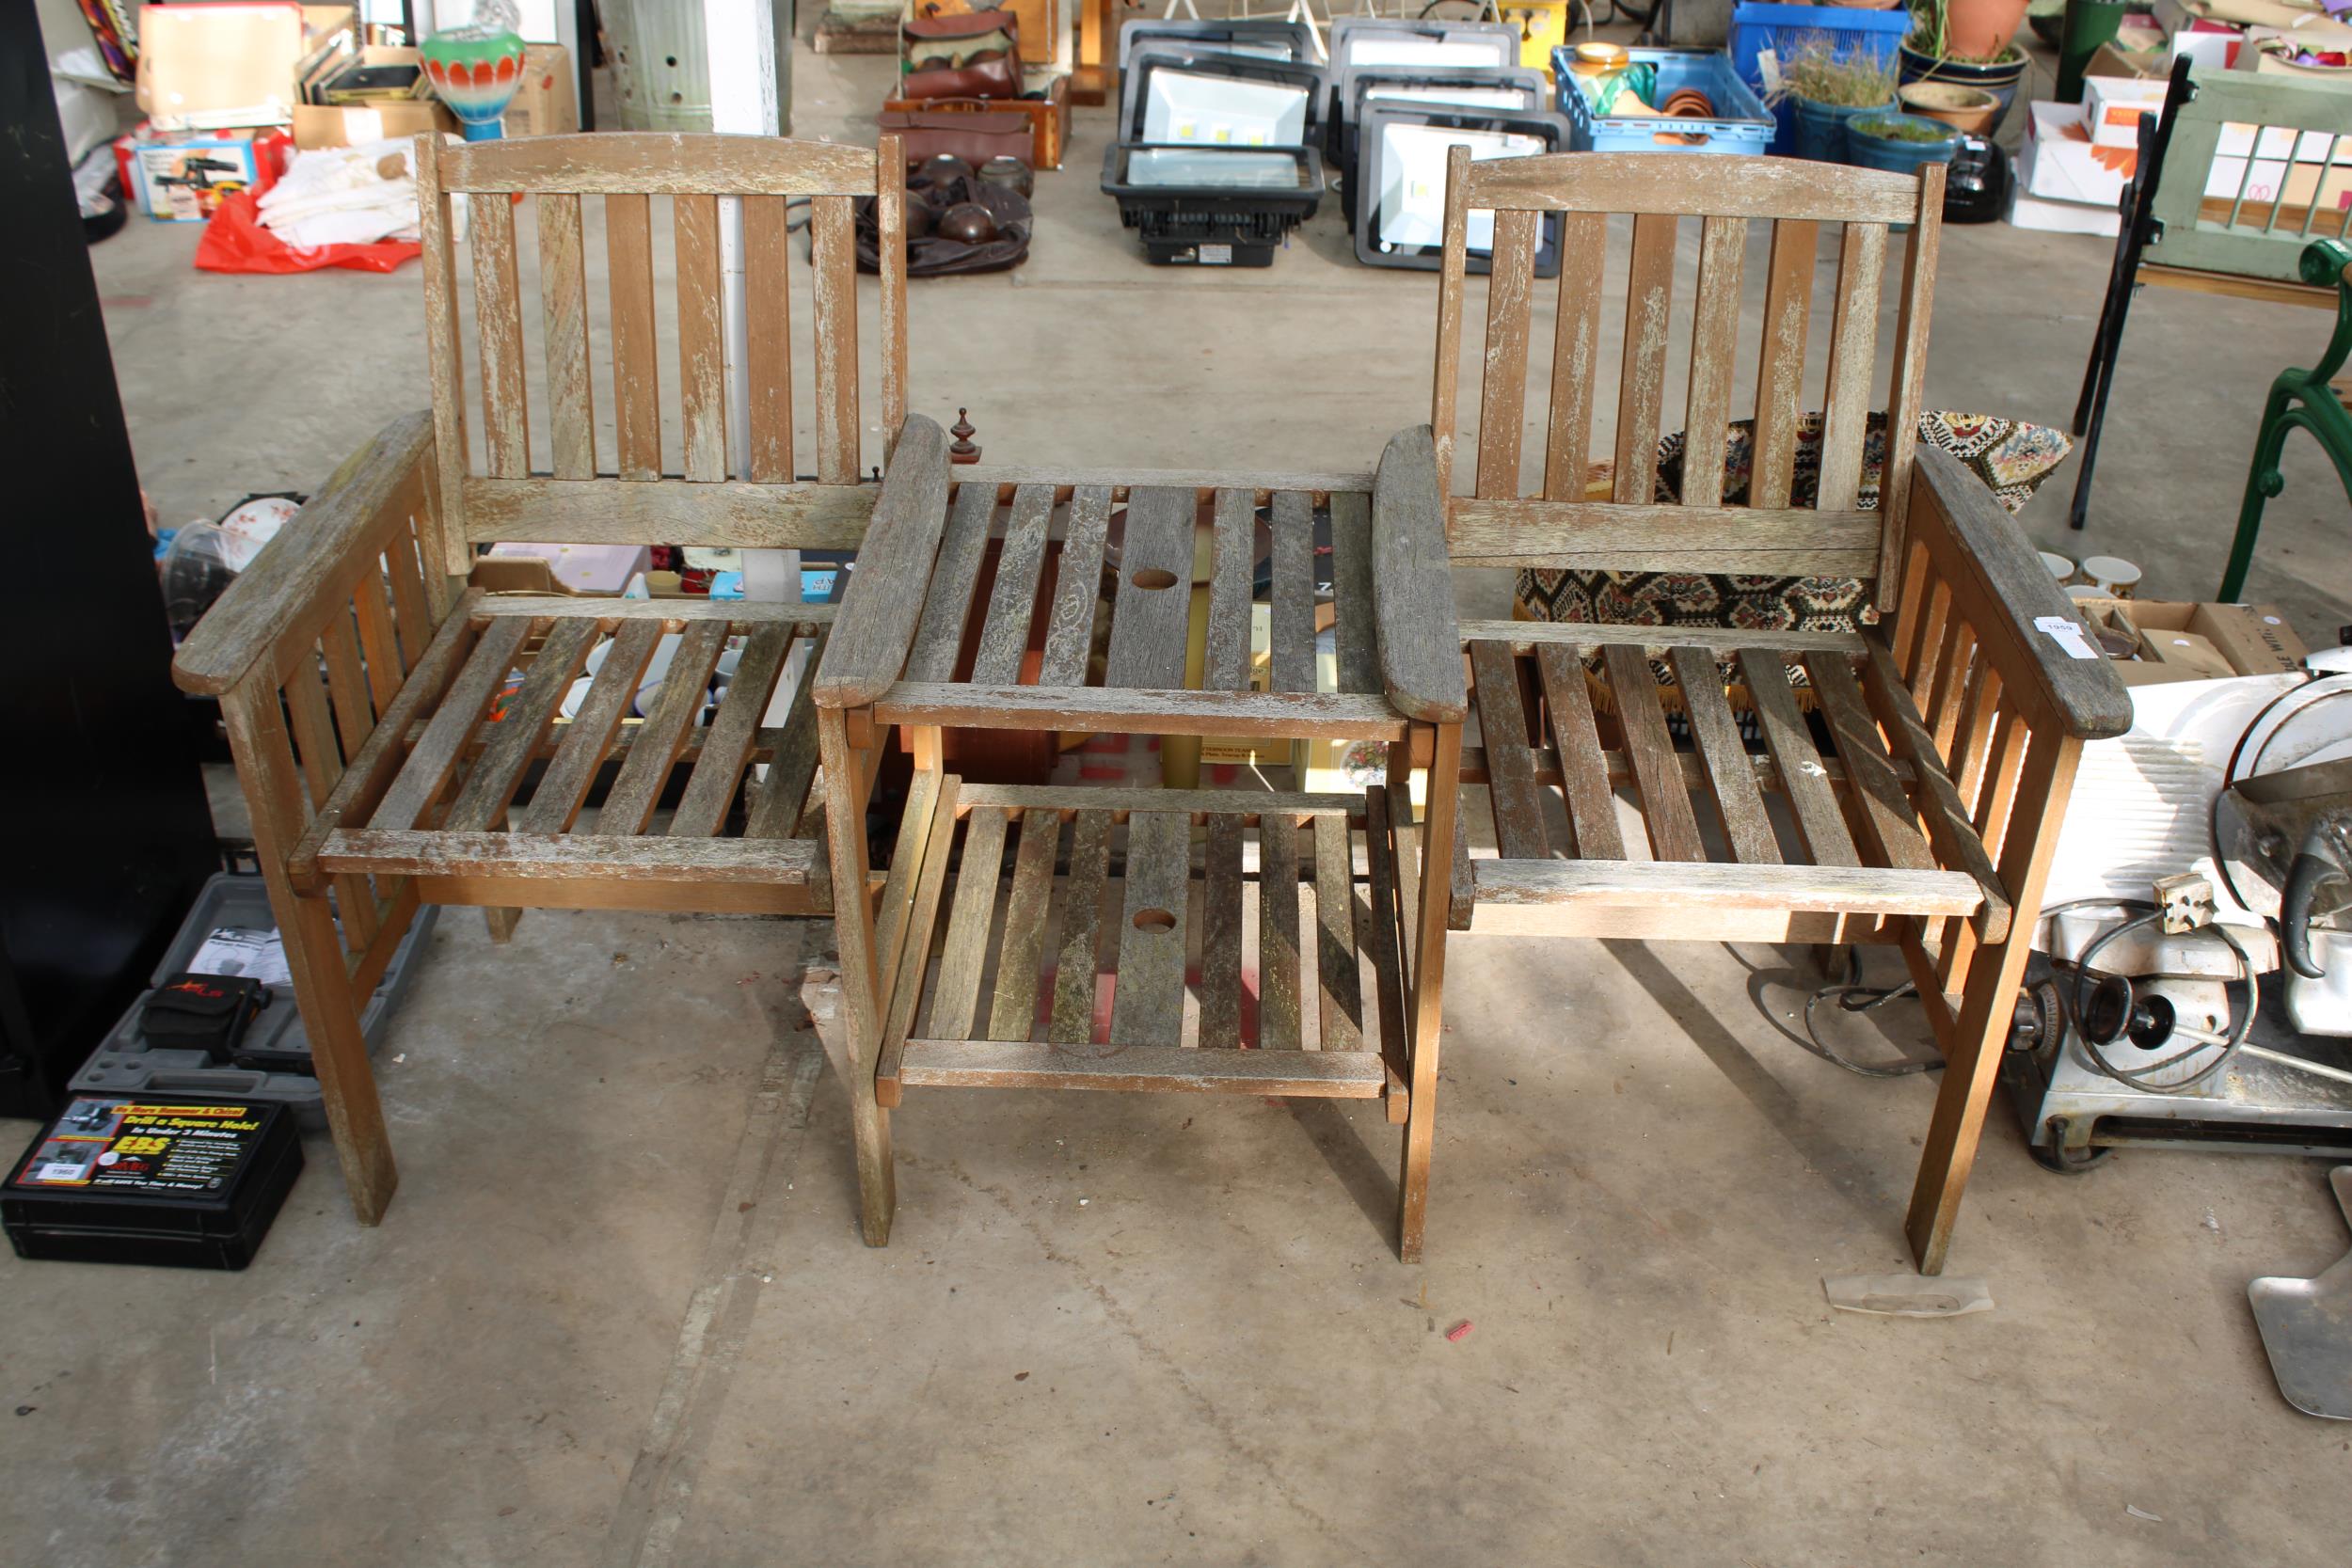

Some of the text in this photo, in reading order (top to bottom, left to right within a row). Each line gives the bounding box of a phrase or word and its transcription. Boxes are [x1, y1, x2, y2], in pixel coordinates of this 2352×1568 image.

[123, 1116, 158, 1125] Drill
[167, 1117, 218, 1128] Square
[218, 1120, 261, 1131] Hole!
[192, 1130, 238, 1138] Minutes
[113, 1136, 170, 1151] EBS
